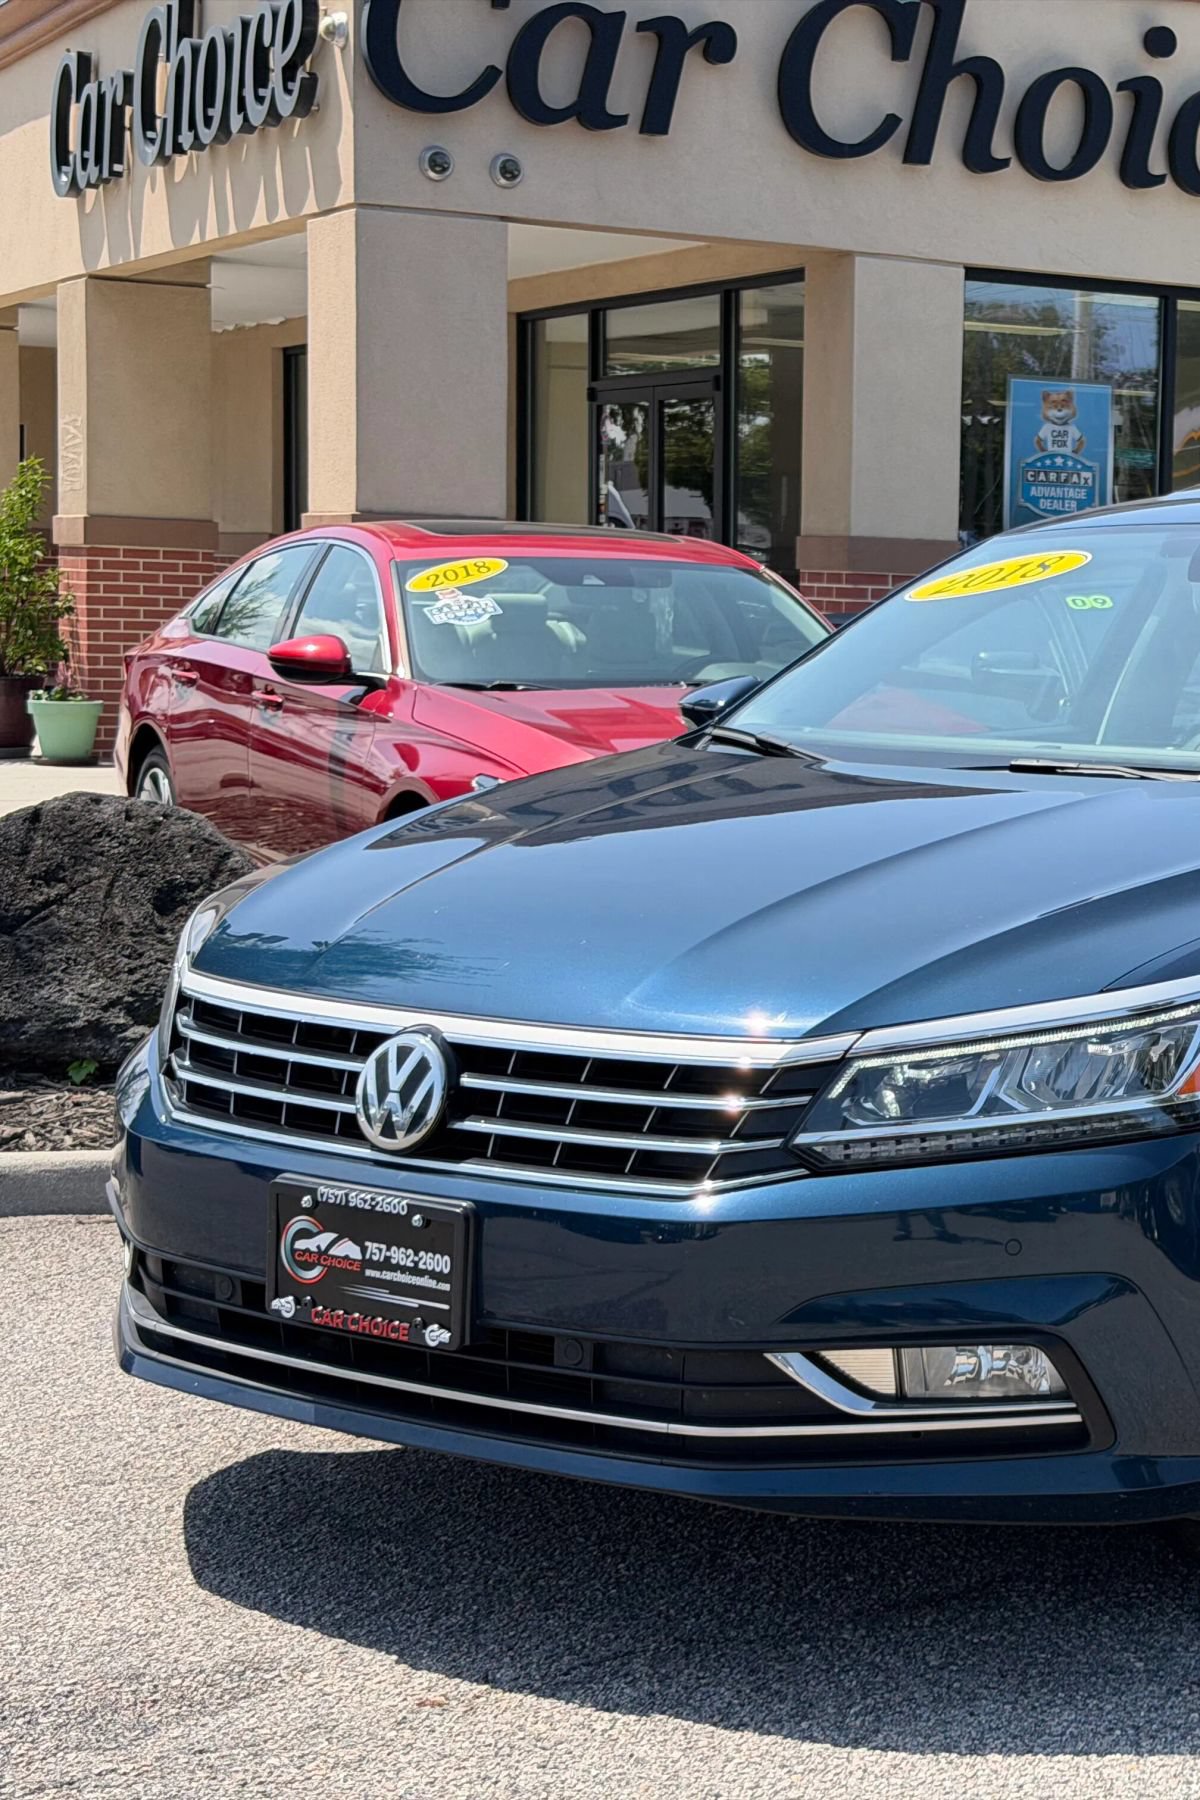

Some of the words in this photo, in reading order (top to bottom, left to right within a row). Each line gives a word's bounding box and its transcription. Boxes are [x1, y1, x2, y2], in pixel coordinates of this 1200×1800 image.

[366, 0, 738, 137] Car
[51, 52, 130, 197] Car
[133, 0, 316, 167] Choice
[1050, 429, 1069, 439] CAR
[1051, 439, 1068, 449] FOX
[1026, 470, 1091, 485] CARFAX
[1030, 486, 1088, 499] ADVANTAGE
[1039, 500, 1077, 512] DEALER
[426, 560, 491, 588] 2018
[927, 556, 1066, 596] 2018
[317, 1185, 346, 1206] (757)
[348, 1190, 408, 1215] 962-2600
[295, 1251, 320, 1263] CAR
[320, 1256, 362, 1271] CHOICE
[364, 1241, 451, 1274] 757-962-2600
[364, 1268, 451, 1291] www.carchoiceonline.com
[311, 1306, 343, 1328] CAR
[347, 1312, 410, 1340] CHOICE
